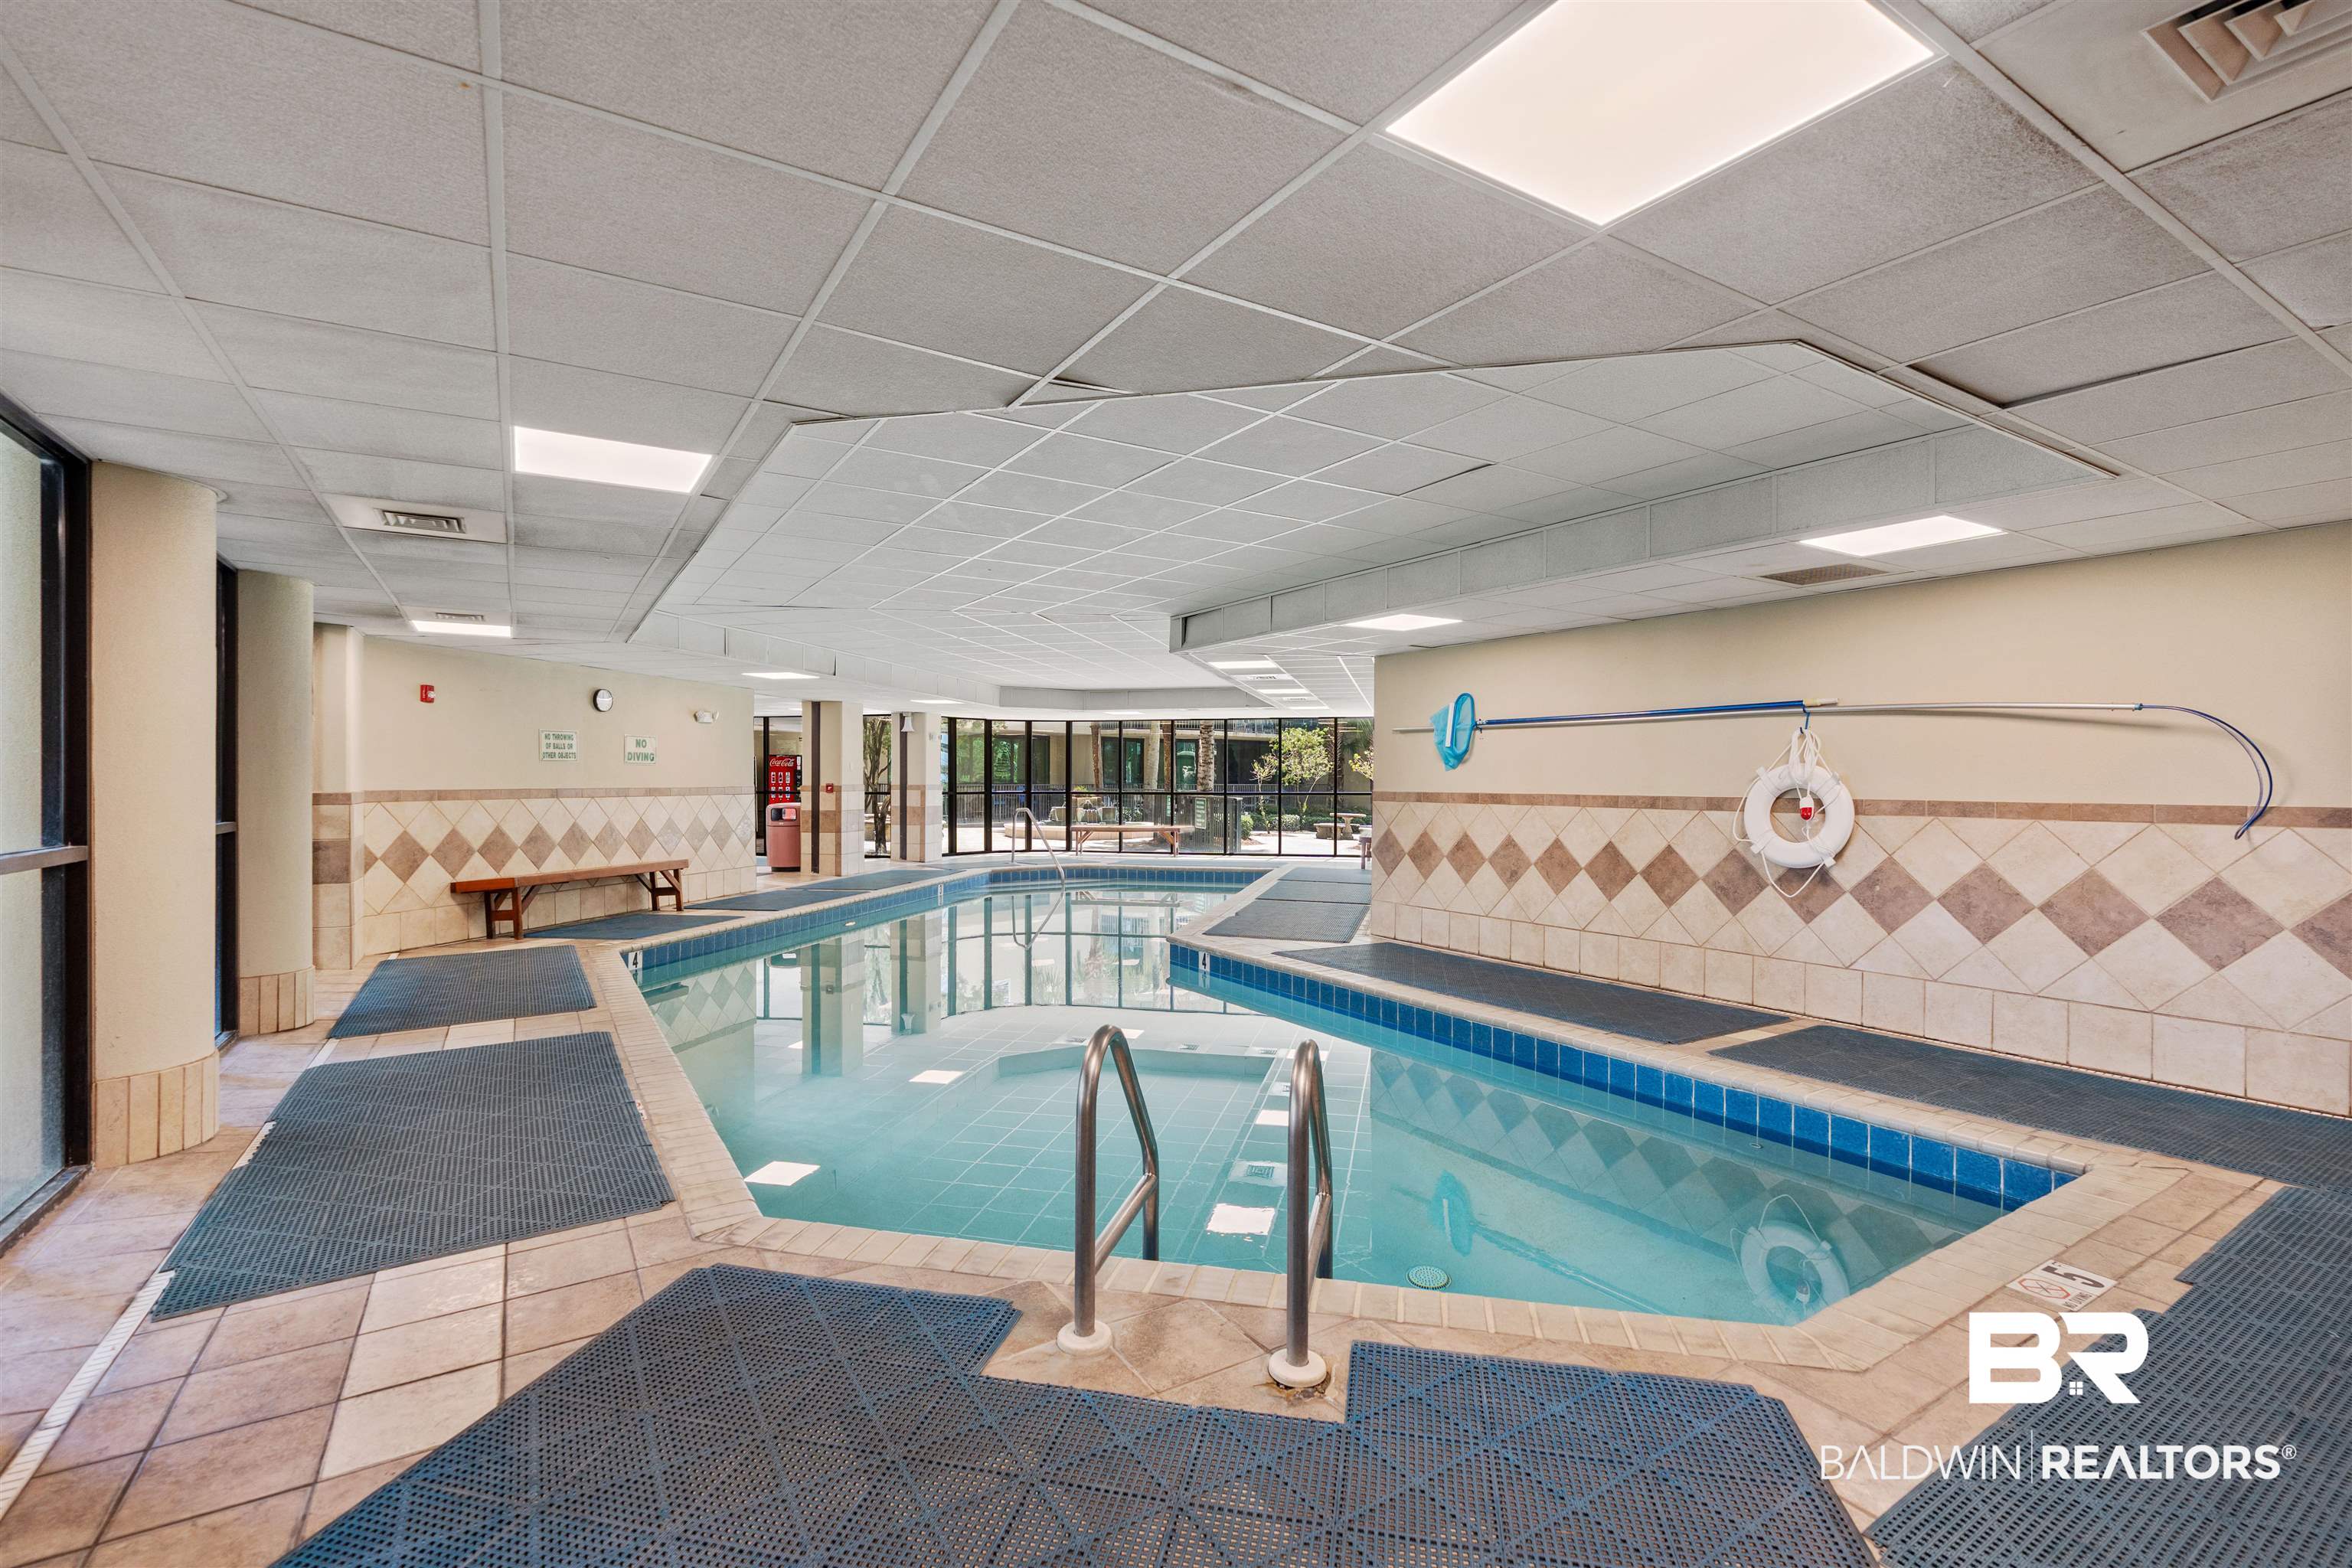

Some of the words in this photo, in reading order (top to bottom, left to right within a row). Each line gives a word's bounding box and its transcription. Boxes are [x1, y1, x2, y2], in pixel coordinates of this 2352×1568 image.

[635, 739, 647, 748] NO
[627, 753, 655, 761] DIVING
[632, 952, 639, 968] 4
[1202, 952, 1207, 969] 4
[2041, 1266, 2105, 1288] 5
